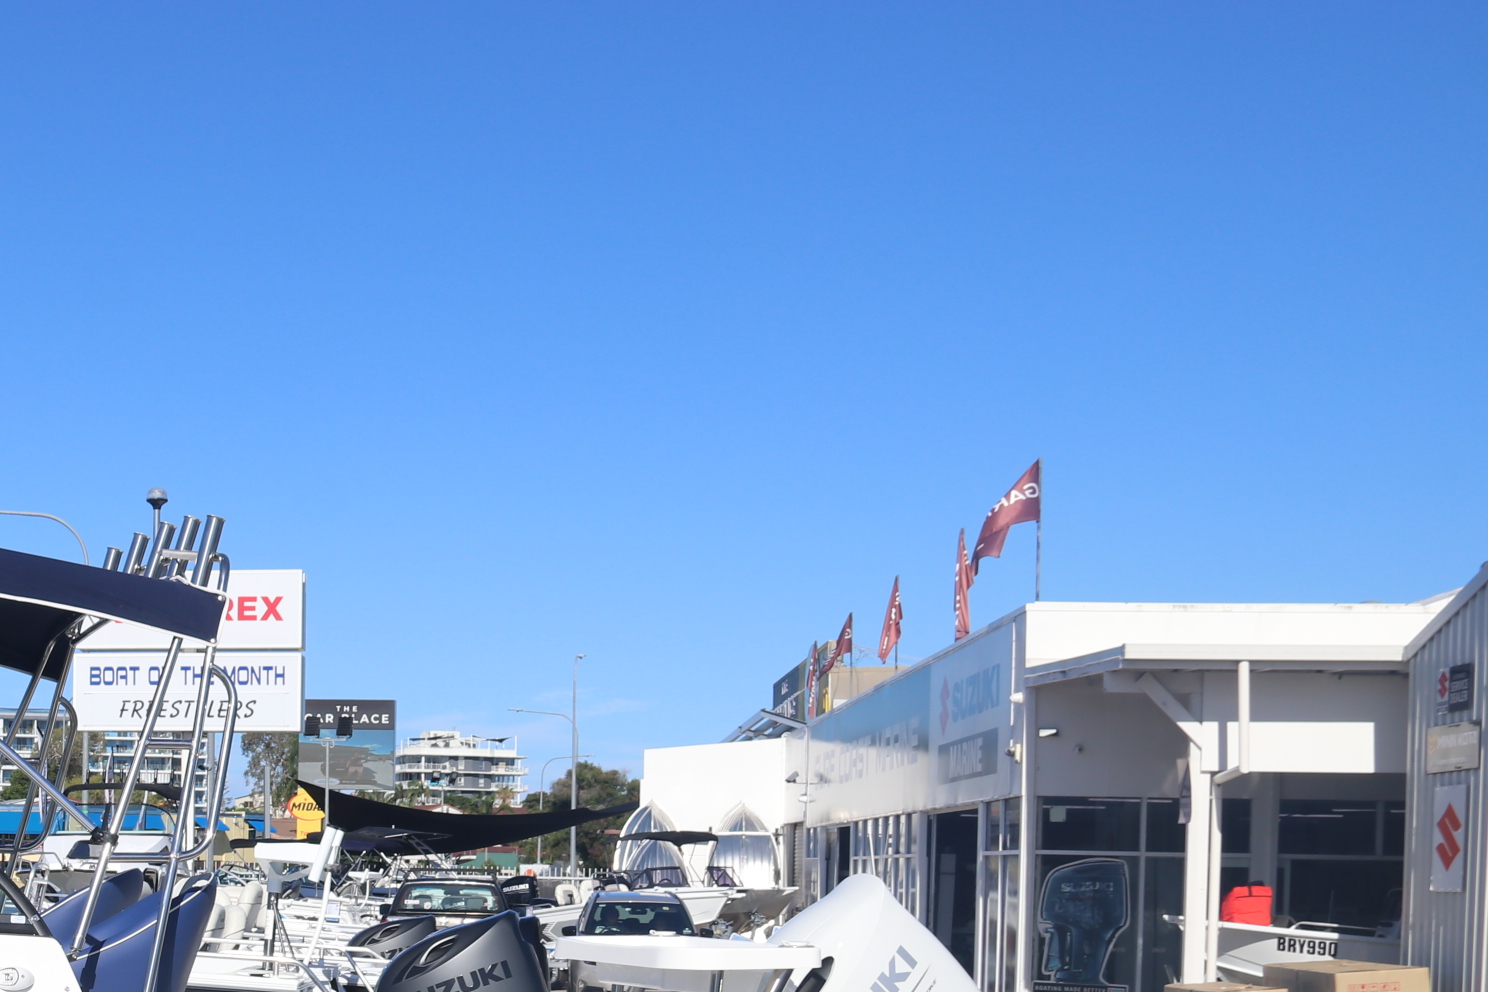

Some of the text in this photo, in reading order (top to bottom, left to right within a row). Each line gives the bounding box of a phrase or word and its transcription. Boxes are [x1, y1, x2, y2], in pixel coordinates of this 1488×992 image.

[89, 666, 140, 686] BOAT
[952, 663, 1001, 724] SUZUKI
[119, 699, 257, 719] FREESTLERS
[292, 802, 322, 811] MIDA
[502, 883, 530, 892] SUZUKI
